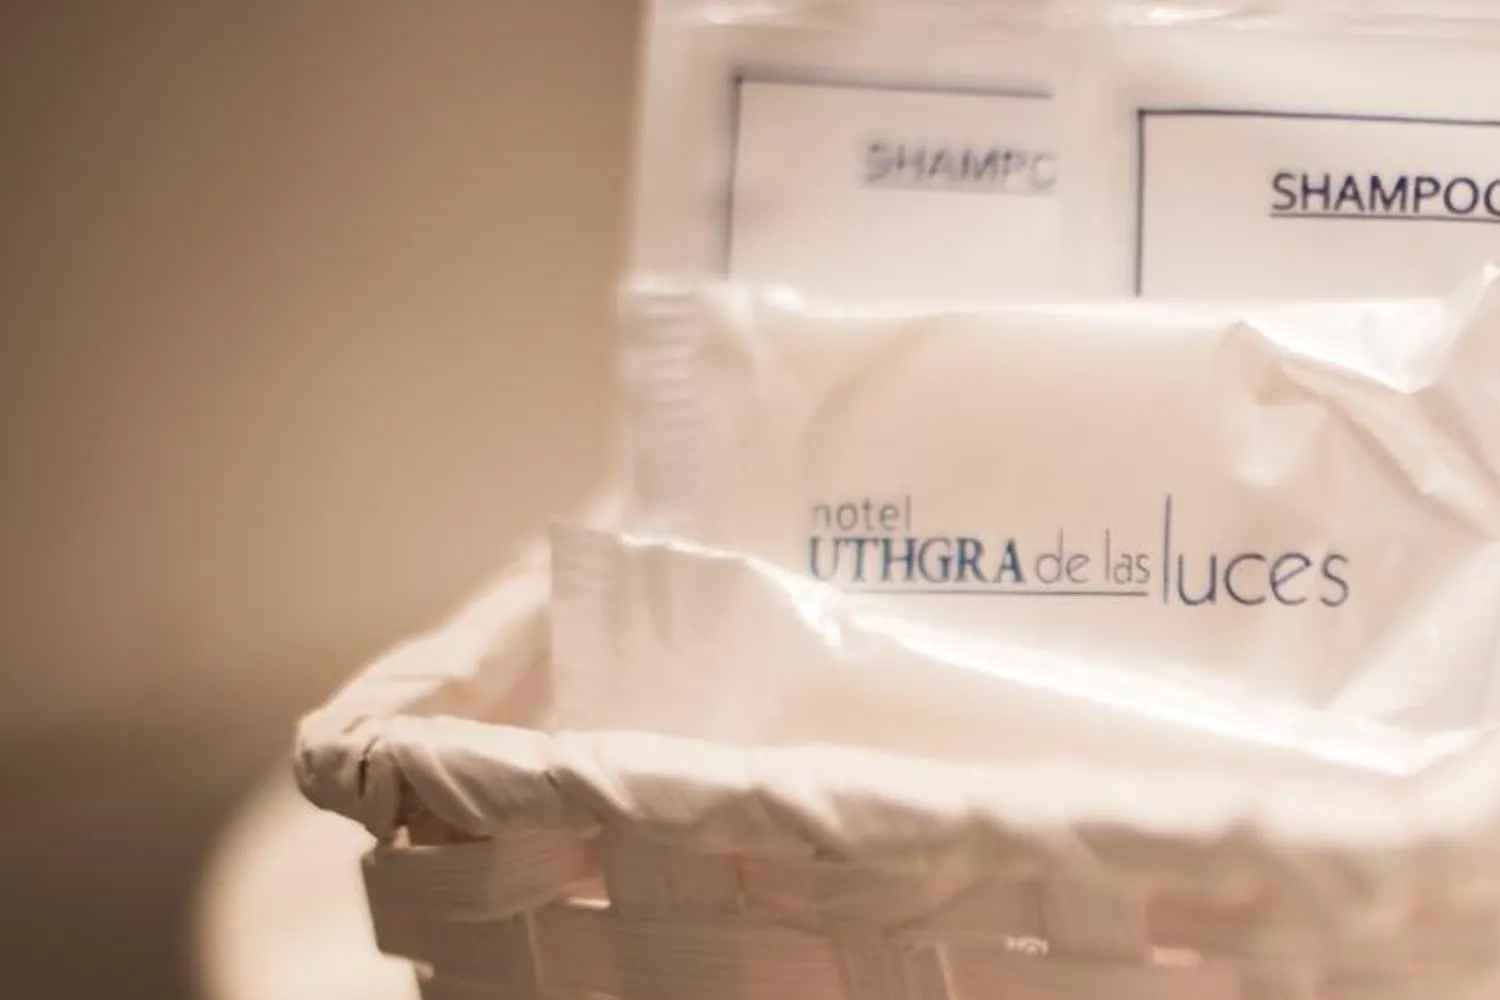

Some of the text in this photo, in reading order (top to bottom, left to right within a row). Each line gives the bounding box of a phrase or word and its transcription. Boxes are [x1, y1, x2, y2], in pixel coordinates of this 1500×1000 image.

[807, 494, 1350, 607] UTHGRA de las luces
